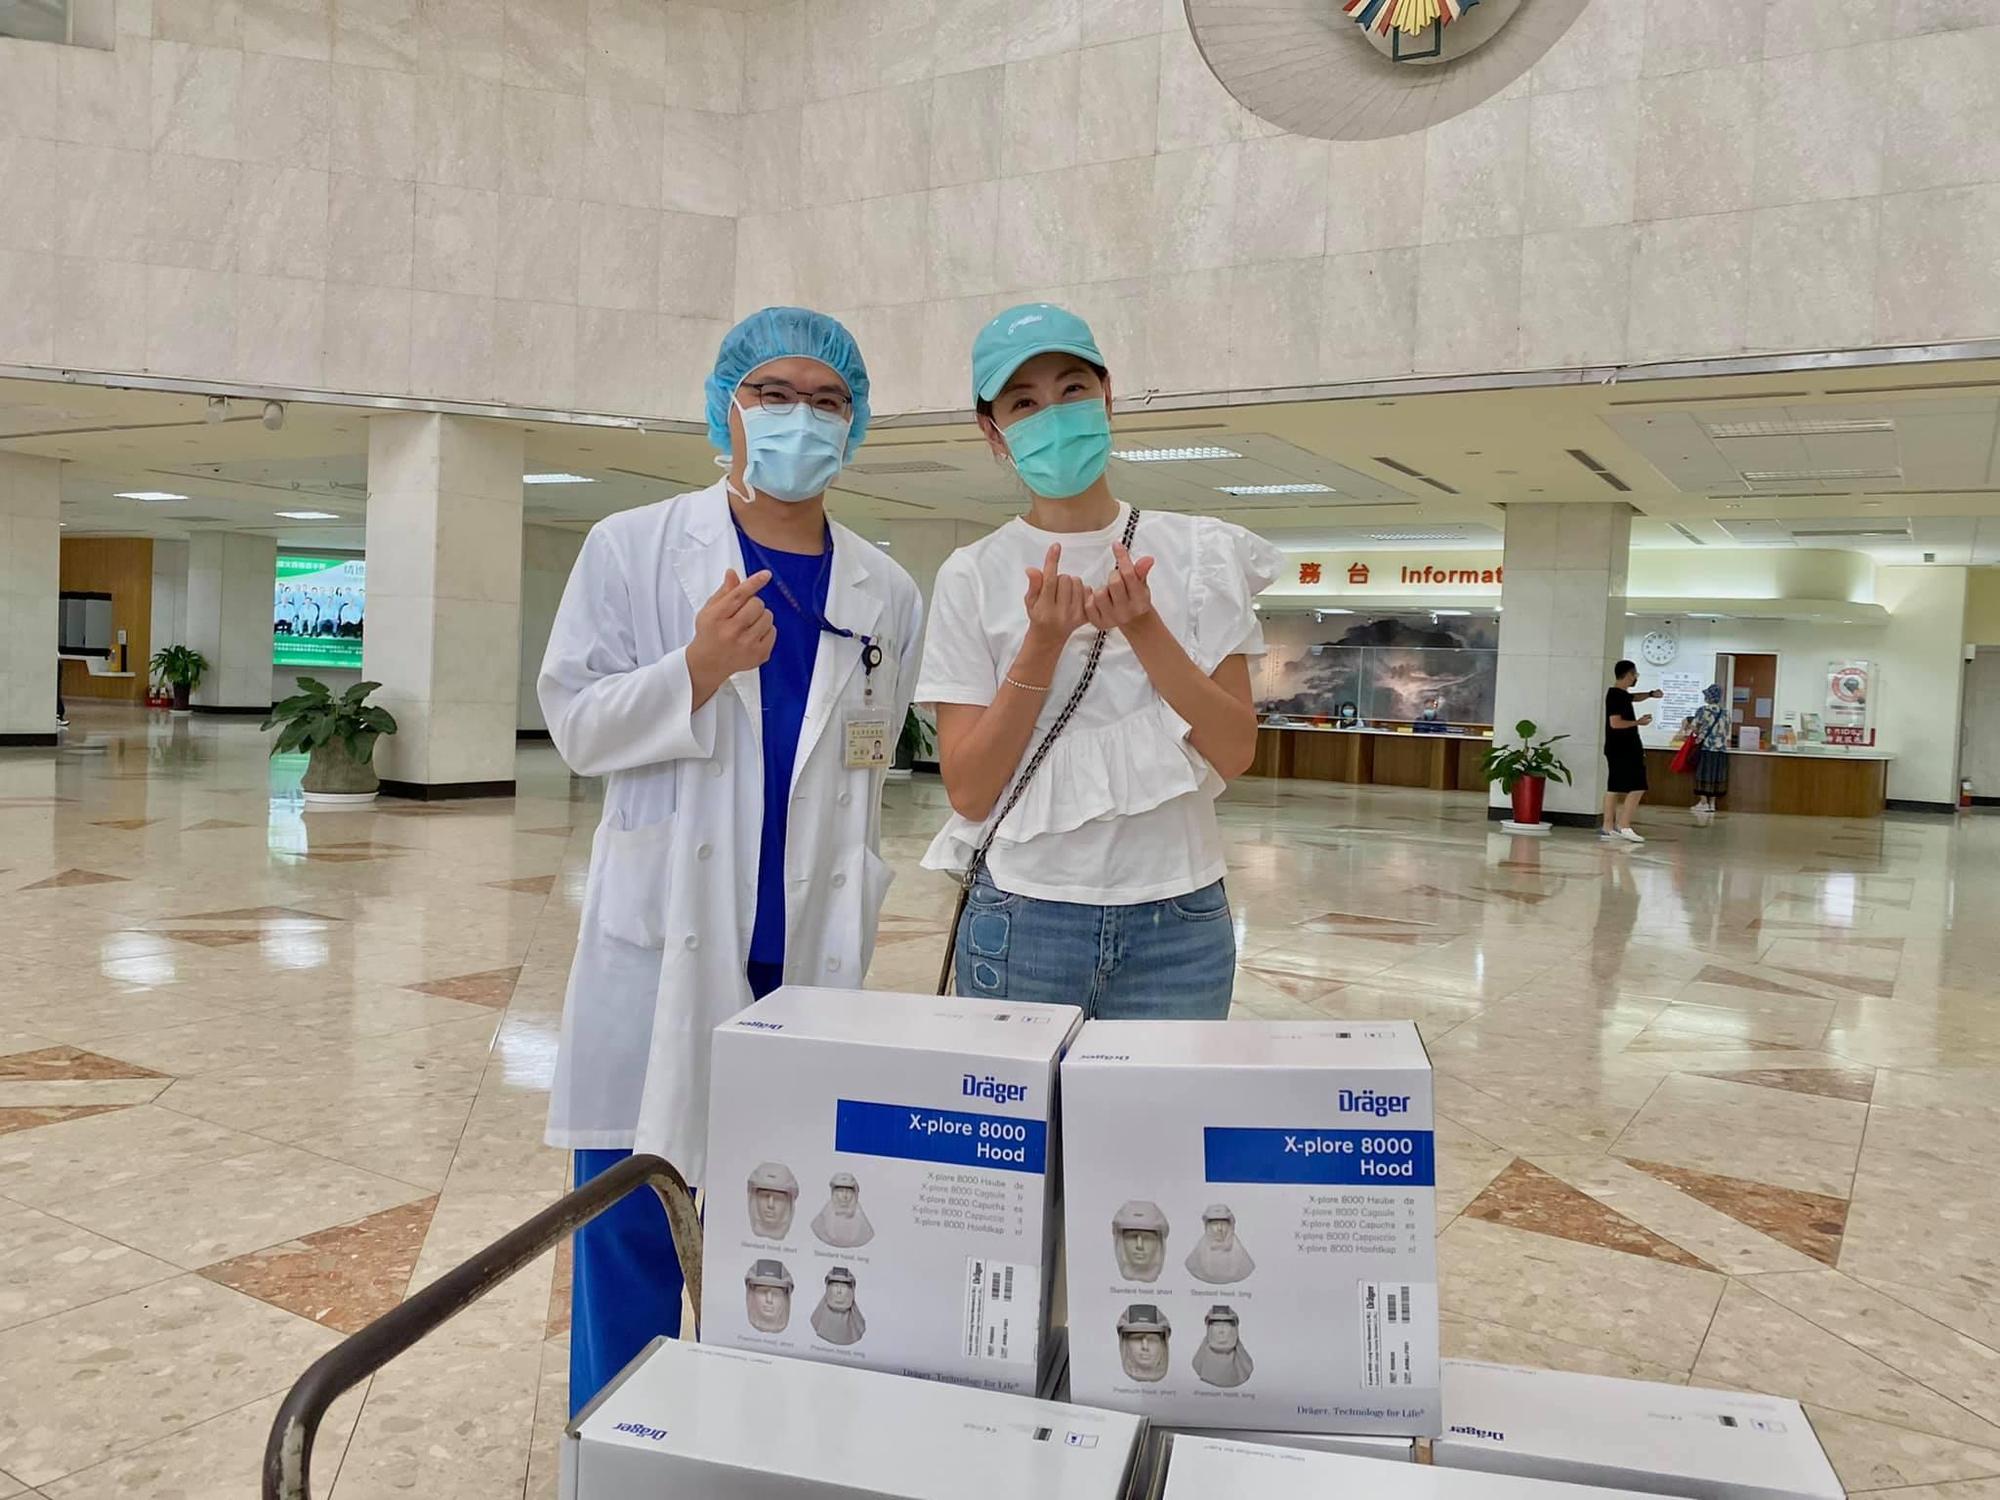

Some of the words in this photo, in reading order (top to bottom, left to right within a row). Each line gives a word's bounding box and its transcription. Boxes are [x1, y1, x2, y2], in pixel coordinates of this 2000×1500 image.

[1401, 565, 1503, 584] Informat
[962, 1074, 1028, 1104] Dräger
[1338, 1089, 1411, 1117] Dräger
[909, 1113, 973, 1136] X-plore
[979, 1121, 1026, 1141] 8000
[977, 1141, 1025, 1162] Hood
[1284, 1135, 1354, 1157] X-plore
[1361, 1137, 1413, 1155] 8000
[1360, 1159, 1413, 1176] Hood
